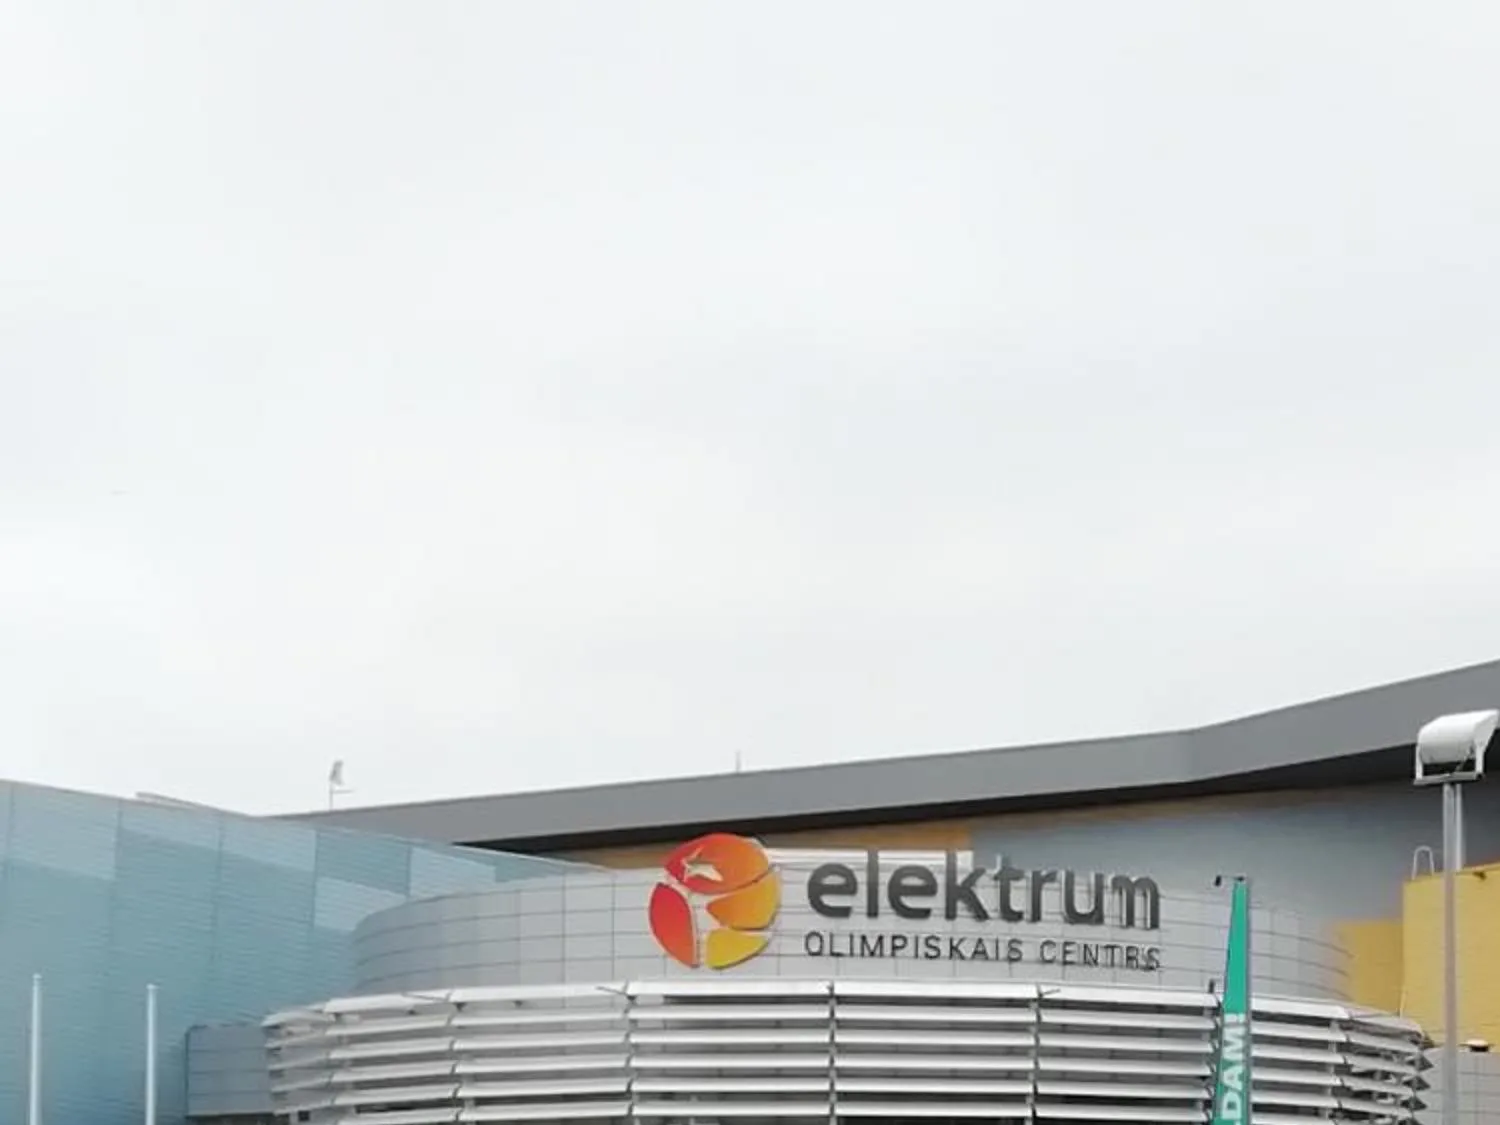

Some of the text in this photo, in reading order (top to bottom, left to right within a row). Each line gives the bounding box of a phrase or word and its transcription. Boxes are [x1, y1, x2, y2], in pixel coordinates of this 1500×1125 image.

[807, 849, 1161, 930] elektrum
[804, 930, 1161, 972] OLIMPISKAIS CENTRS
